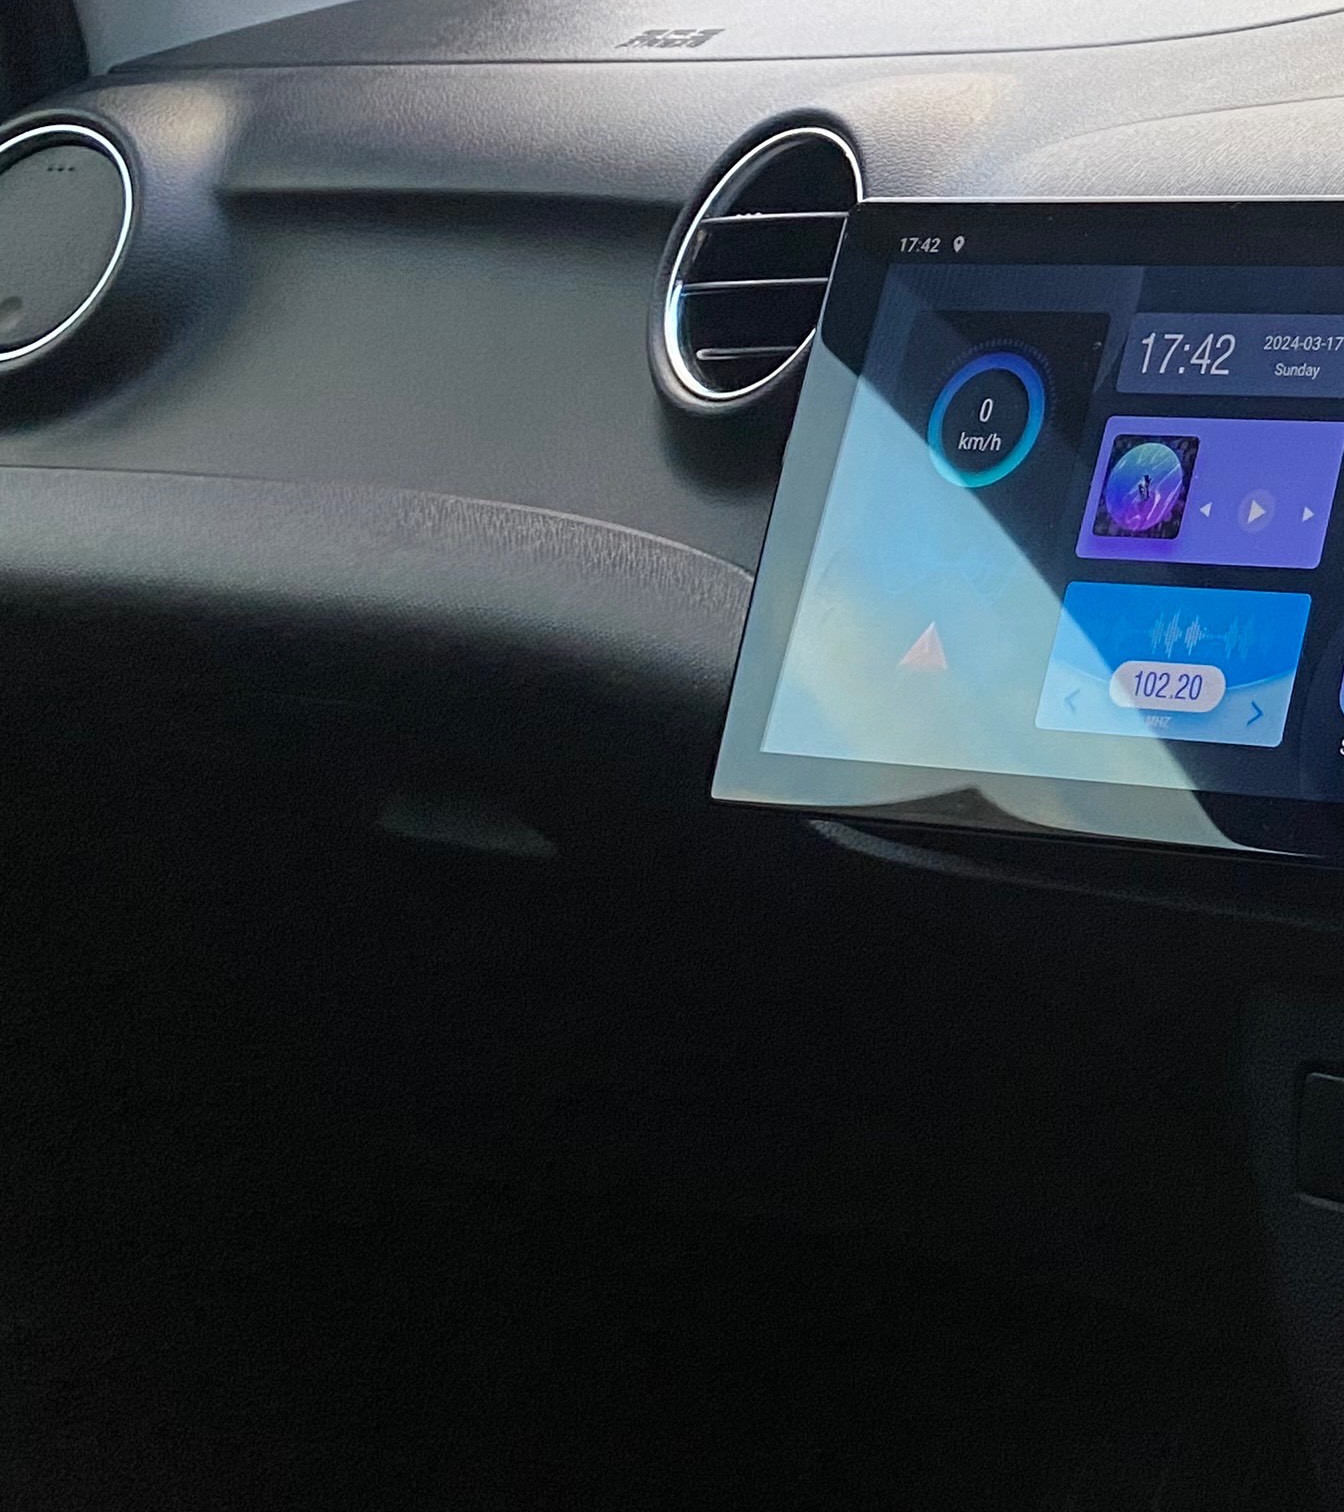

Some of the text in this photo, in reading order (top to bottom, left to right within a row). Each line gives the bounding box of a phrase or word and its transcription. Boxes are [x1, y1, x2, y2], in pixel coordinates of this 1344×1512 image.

[900, 236, 941, 253] 17:42
[1140, 331, 1236, 376] 17:42
[1263, 335, 1344, 352] 2024-03-17
[1274, 362, 1320, 380] Sunday
[978, 398, 994, 423] 0
[958, 431, 1001, 452] km/h
[1134, 670, 1203, 701] 102.20
